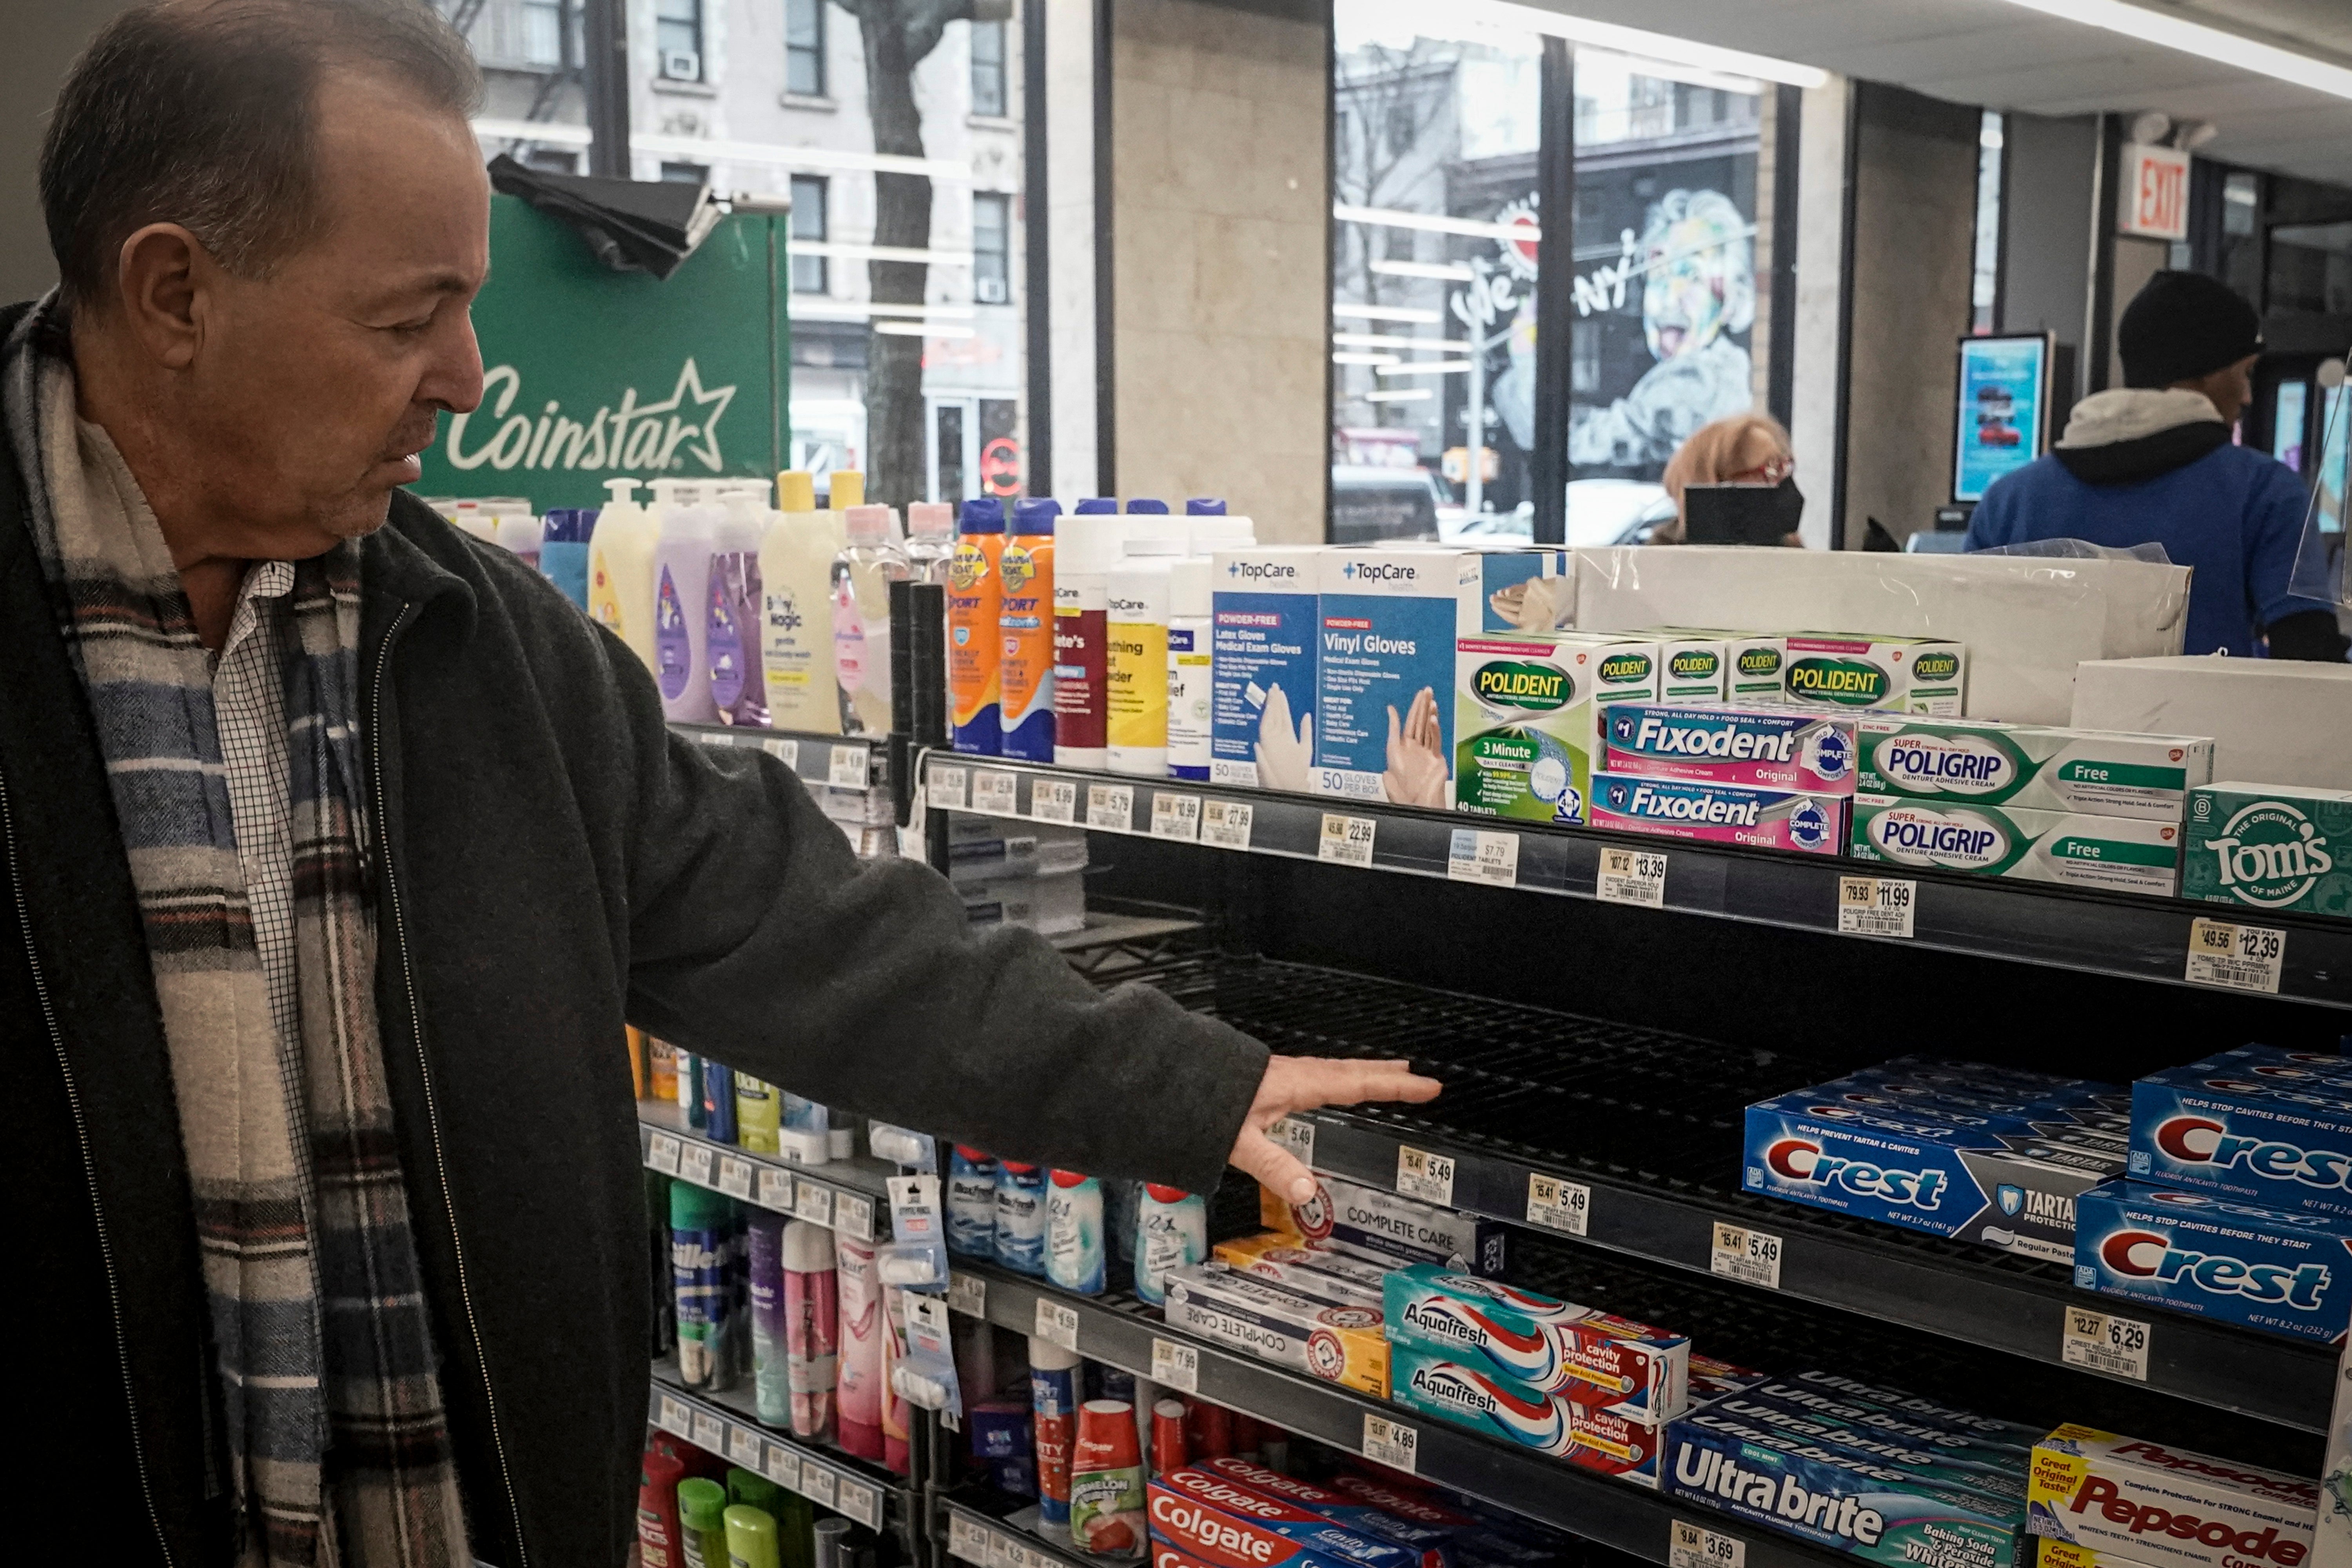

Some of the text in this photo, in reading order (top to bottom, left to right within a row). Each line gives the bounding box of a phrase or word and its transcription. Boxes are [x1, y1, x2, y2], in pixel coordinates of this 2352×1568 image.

[2139, 158, 2186, 232] EXIT
[446, 364, 699, 470] Coinstar
[1240, 563, 1294, 582] TopCare
[1357, 564, 1415, 583] TopCare
[1002, 598, 1039, 611] PORT
[1218, 614, 1277, 625] POWDER-FREE
[1216, 630, 1265, 641] Latex Gloves
[1325, 633, 1416, 655] Vinyl Gloves
[1216, 642, 1301, 655] Medical Exam Gloves
[1603, 661, 1646, 676] POLIDENT
[1673, 658, 1714, 671] POLIDENT
[1741, 655, 1777, 669] POLIDENT
[1917, 660, 1954, 673] POLIDENT
[1481, 671, 1562, 697] POLIDENT
[1793, 668, 1878, 693] POLIDENT
[1635, 717, 1794, 762] Fixodent
[1894, 739, 1920, 749] SUPER
[1484, 742, 1531, 759] 3 Minute
[1216, 764, 1228, 776] 50
[1889, 748, 2002, 780] POLIGRIP
[2075, 765, 2108, 781] Free
[1323, 772, 1342, 790] 50
[1756, 769, 1797, 782] Original
[1902, 774, 1934, 782] DENTURE
[1935, 776, 1970, 786] ADHESIVE
[1457, 801, 1496, 816] 40 TABLETS
[1630, 787, 1760, 826] Fixodent
[1889, 811, 1915, 822] SUPER
[1790, 820, 1828, 831] COMPLETE
[2234, 813, 2297, 837] THE ORIGINAL
[1735, 831, 1775, 846] Original
[1883, 822, 1995, 854] POLIGRIP
[1485, 845, 1504, 857] $7.79
[1896, 847, 1928, 855] DENTURE
[1929, 849, 1962, 860] ADHESIVE
[2067, 842, 2100, 858] Free
[2205, 822, 2332, 885] Tom's
[1636, 858, 1663, 878] $13.39
[1877, 887, 1909, 907] $11.99
[2251, 879, 2298, 897] OF MAINE
[2239, 934, 2279, 958] $12.39
[2181, 1097, 2337, 1131] HELPS STOP CAVITIES BEFORE THEY
[1797, 1124, 1820, 1136] HELPS
[1820, 1129, 1852, 1142] PREVENT
[1853, 1136, 1879, 1147] TARTAR
[1888, 1142, 1920, 1155] CAVITIES
[2154, 1115, 2352, 1194] Cres
[1427, 1160, 1450, 1181] $5.49
[1767, 1137, 1948, 1210] Crest
[1559, 1189, 1584, 1210] $5.49
[2220, 1183, 2258, 1196] TOOTHPASTE
[1818, 1196, 1849, 1209] TOOTHPASTE
[2302, 1199, 2347, 1214] NET WT 8.2
[1887, 1211, 1912, 1223] NET WT
[1347, 1207, 1455, 1252] COMPLETE CARE
[2126, 1211, 2312, 1250] HELPS STOP CAVITIES BEFORE THEY START
[1748, 1238, 1777, 1261] $5.49
[2017, 1240, 2074, 1259] Regular Paste
[2099, 1229, 2332, 1310] Crest
[2166, 1298, 2205, 1312] TOOTHPASTE
[1187, 1307, 1286, 1352] COMPLETE CARE
[1403, 1302, 1488, 1346] Aquafresh
[2248, 1314, 2279, 1326] NET WT
[2108, 1324, 2144, 1350] $6.29
[1586, 1343, 1621, 1363] cavity
[2071, 1339, 2122, 1356] CREST REGULAR
[1564, 1349, 1620, 1373] protection
[1412, 1369, 1497, 1412] Aquafresh
[1572, 1417, 1628, 1442] protection
[1595, 1412, 1628, 1432] cavity
[2041, 1457, 2071, 1471] Great
[1214, 1457, 1325, 1501] Colgate
[2034, 1466, 2078, 1485] Original
[1171, 1471, 1283, 1518] Colgate
[2039, 1479, 2071, 1494] Taste!
[2124, 1480, 2301, 1530] Complete Protection For STRONG Enamel and
[1152, 1495, 1273, 1563] Colgate
[1731, 1503, 1832, 1541] ANTICAVITY FLUORIDE TOOTHPASTE
[2069, 1475, 2307, 1567] Pepsode
[1705, 1537, 1733, 1559] $3.69
[1924, 1523, 1965, 1548] Baking
[1966, 1537, 1996, 1555] Soda
[2078, 1524, 2109, 1538] WHITENS
[2110, 1531, 2130, 1542] TEETH
[2135, 1539, 2183, 1556] STRENGTHENS
[2185, 1551, 2212, 1564] ENAMEL
[1933, 1539, 1942, 1551] &
[1944, 1542, 1995, 1568] Peroxide
[2051, 1546, 2080, 1561] Great
